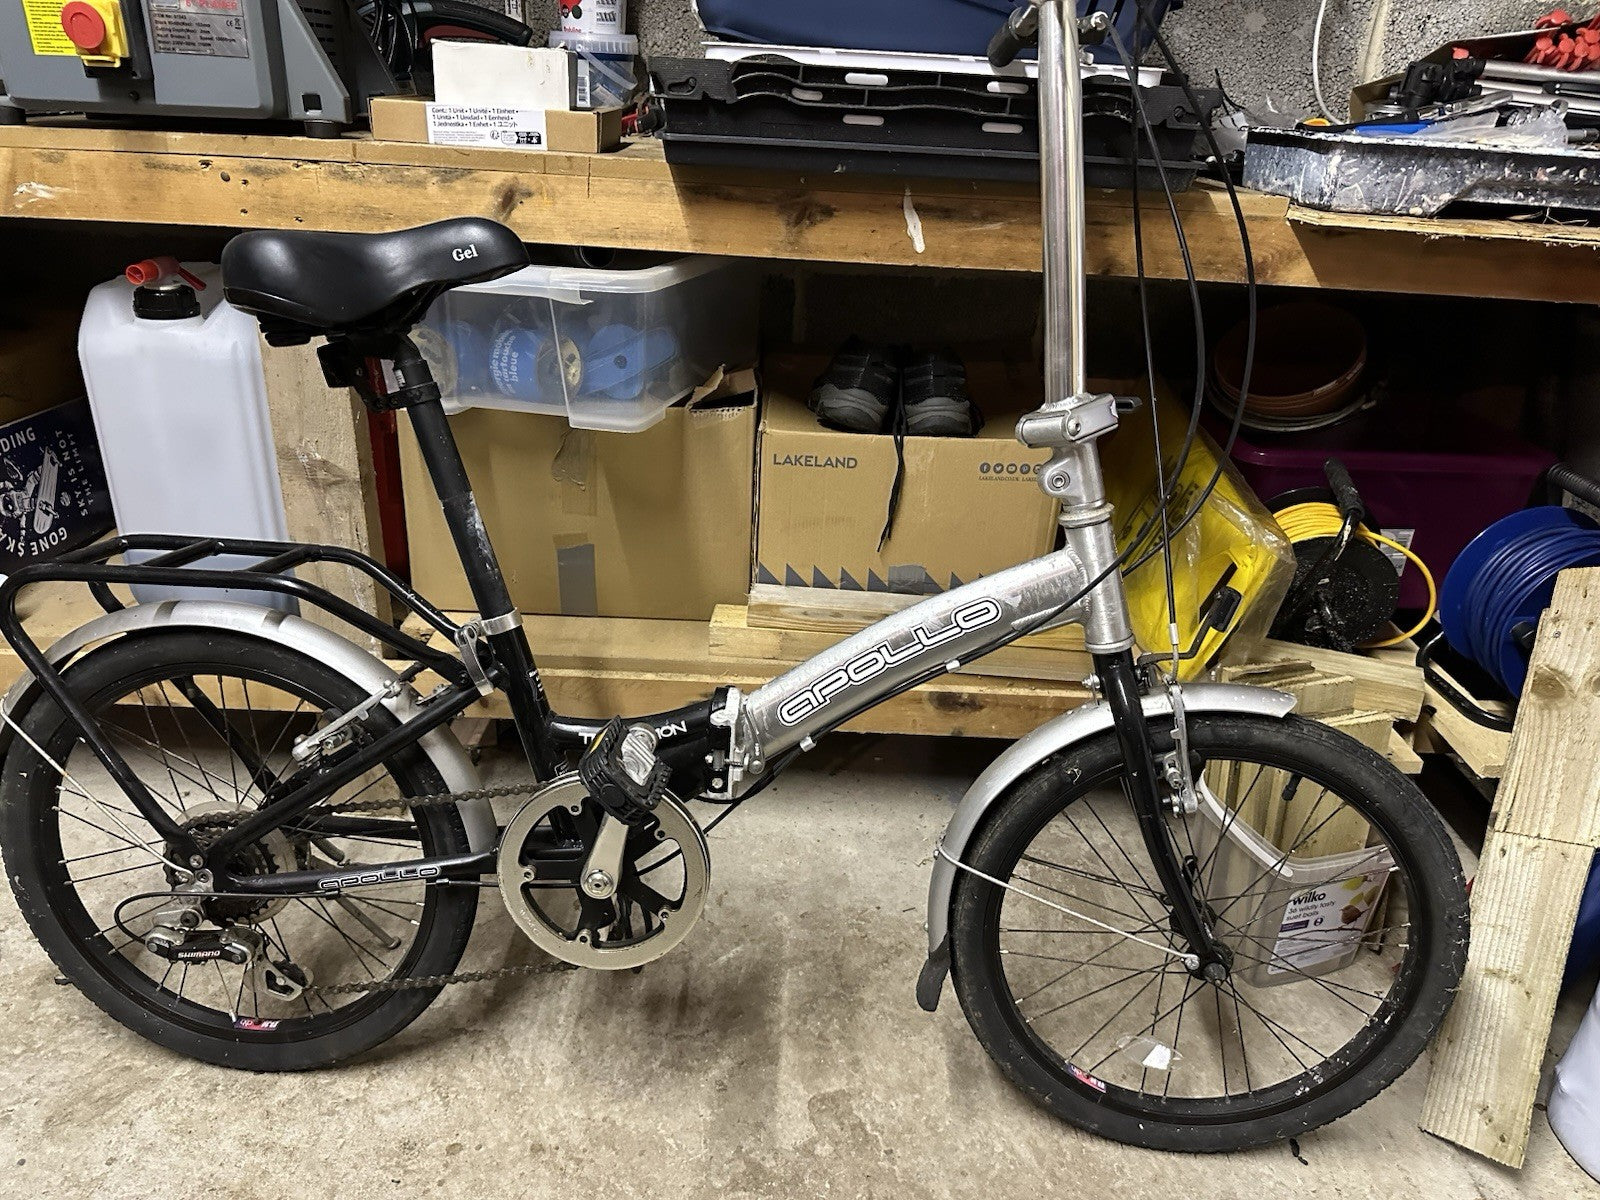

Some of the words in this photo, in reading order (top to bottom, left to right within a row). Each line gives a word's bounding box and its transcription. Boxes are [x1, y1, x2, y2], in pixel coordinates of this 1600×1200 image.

[452, 244, 479, 262] Gel
[508, 351, 519, 382] bleue
[55, 430, 71, 462] NOT
[773, 453, 858, 469] LAKELAND
[67, 468, 77, 483] IS
[74, 490, 88, 516] SKY
[29, 527, 67, 556] GONE
[776, 597, 1002, 728] APOLLO
[318, 865, 440, 891] APOLLO
[1292, 890, 1327, 906] wilko
[1298, 904, 1319, 912] wildly
[1320, 900, 1336, 908] tasty
[1302, 910, 1319, 918] balls
[177, 950, 221, 958] SHIMANO
